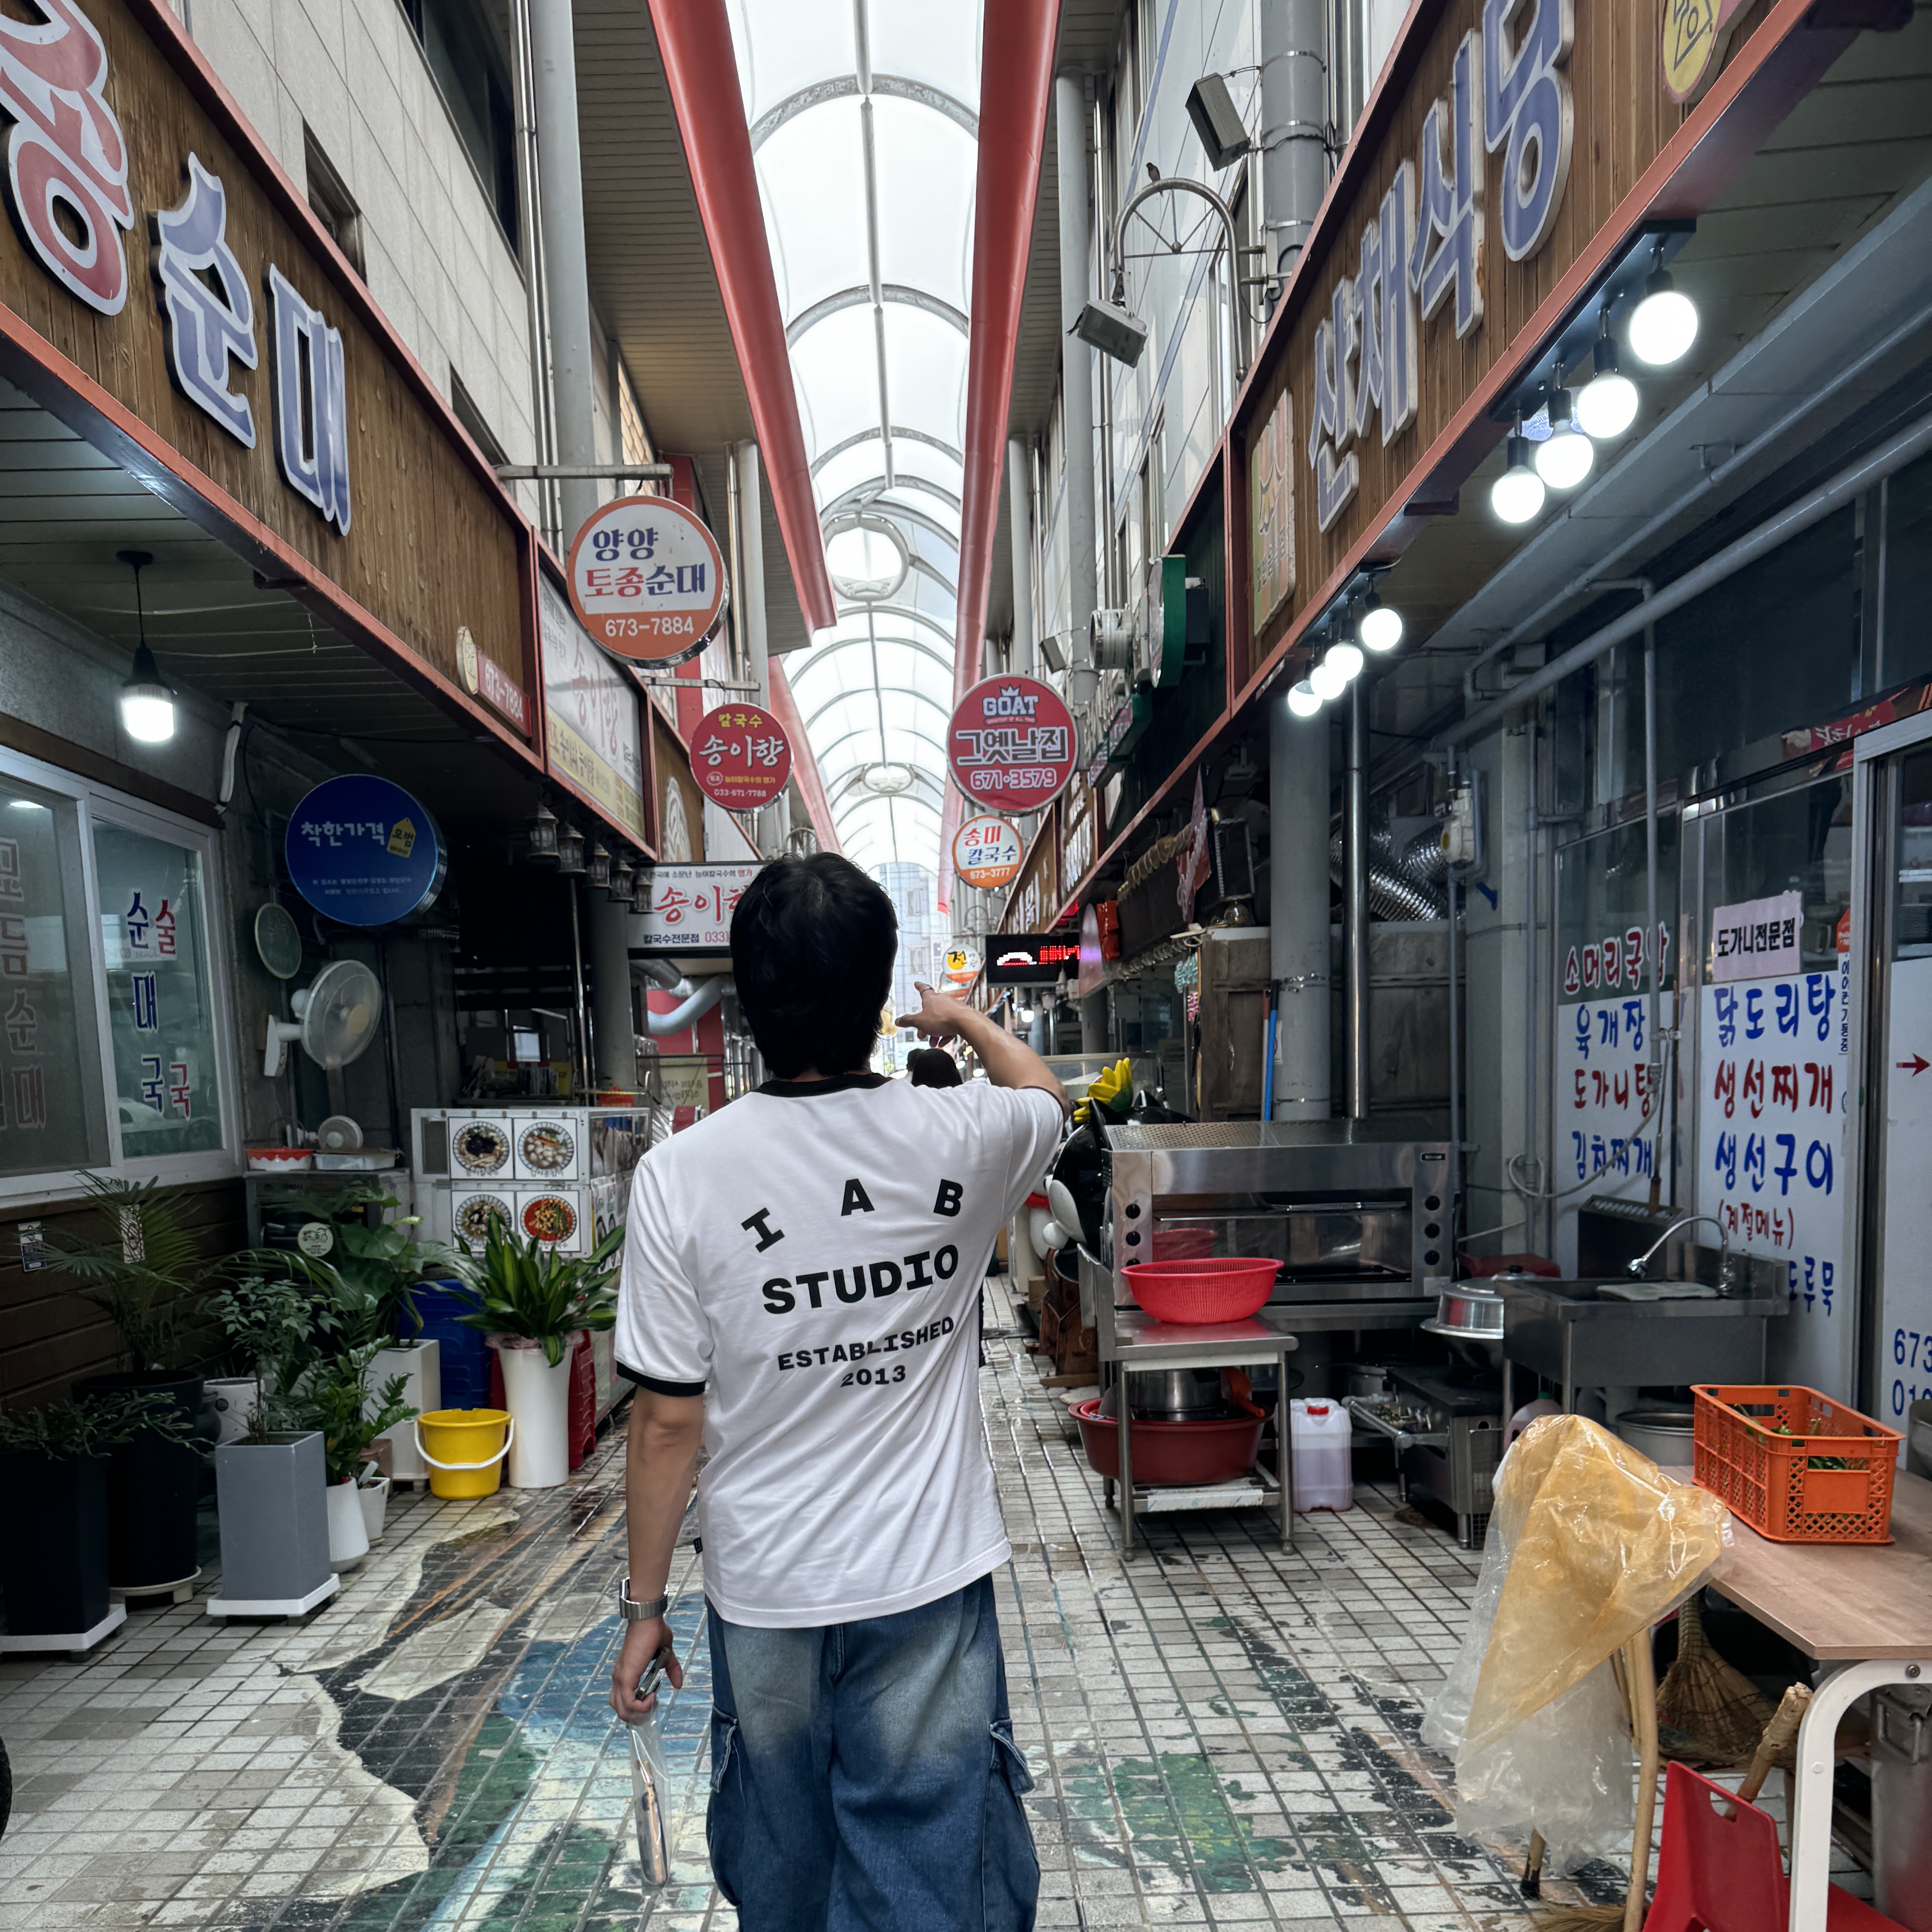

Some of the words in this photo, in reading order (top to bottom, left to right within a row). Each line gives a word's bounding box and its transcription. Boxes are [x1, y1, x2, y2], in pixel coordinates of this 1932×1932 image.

[593, 527, 659, 561] 양양
[585, 563, 705, 598] 토종순대
[605, 616, 694, 637] 673-7884
[718, 713, 763, 728] 칼국수
[982, 695, 1039, 716] GOAT
[699, 734, 784, 768] 송이향
[956, 726, 1069, 766] 그옛날집
[301, 821, 385, 847] 착한가격
[964, 825, 1002, 847] 송미
[968, 845, 1017, 865] 칼국수
[644, 934, 700, 944] 칼국수전문점
[1717, 917, 1796, 957] 도가니전문점
[1576, 998, 1646, 1060] 육개장
[1714, 974, 1836, 1048] 닭도리탕
[1574, 1063, 1654, 1118] 도가니탕
[1715, 1058, 1833, 1119] 생선찌개
[1572, 1130, 1652, 1181] 김치찌개
[1715, 1131, 1833, 1196] 생선구이
[1718, 1199, 1794, 1250] (계절메뉴)
[762, 1244, 959, 1314] STUDIO
[778, 1316, 954, 1371] ESTABLISHED
[840, 1365, 907, 1388] 2013
